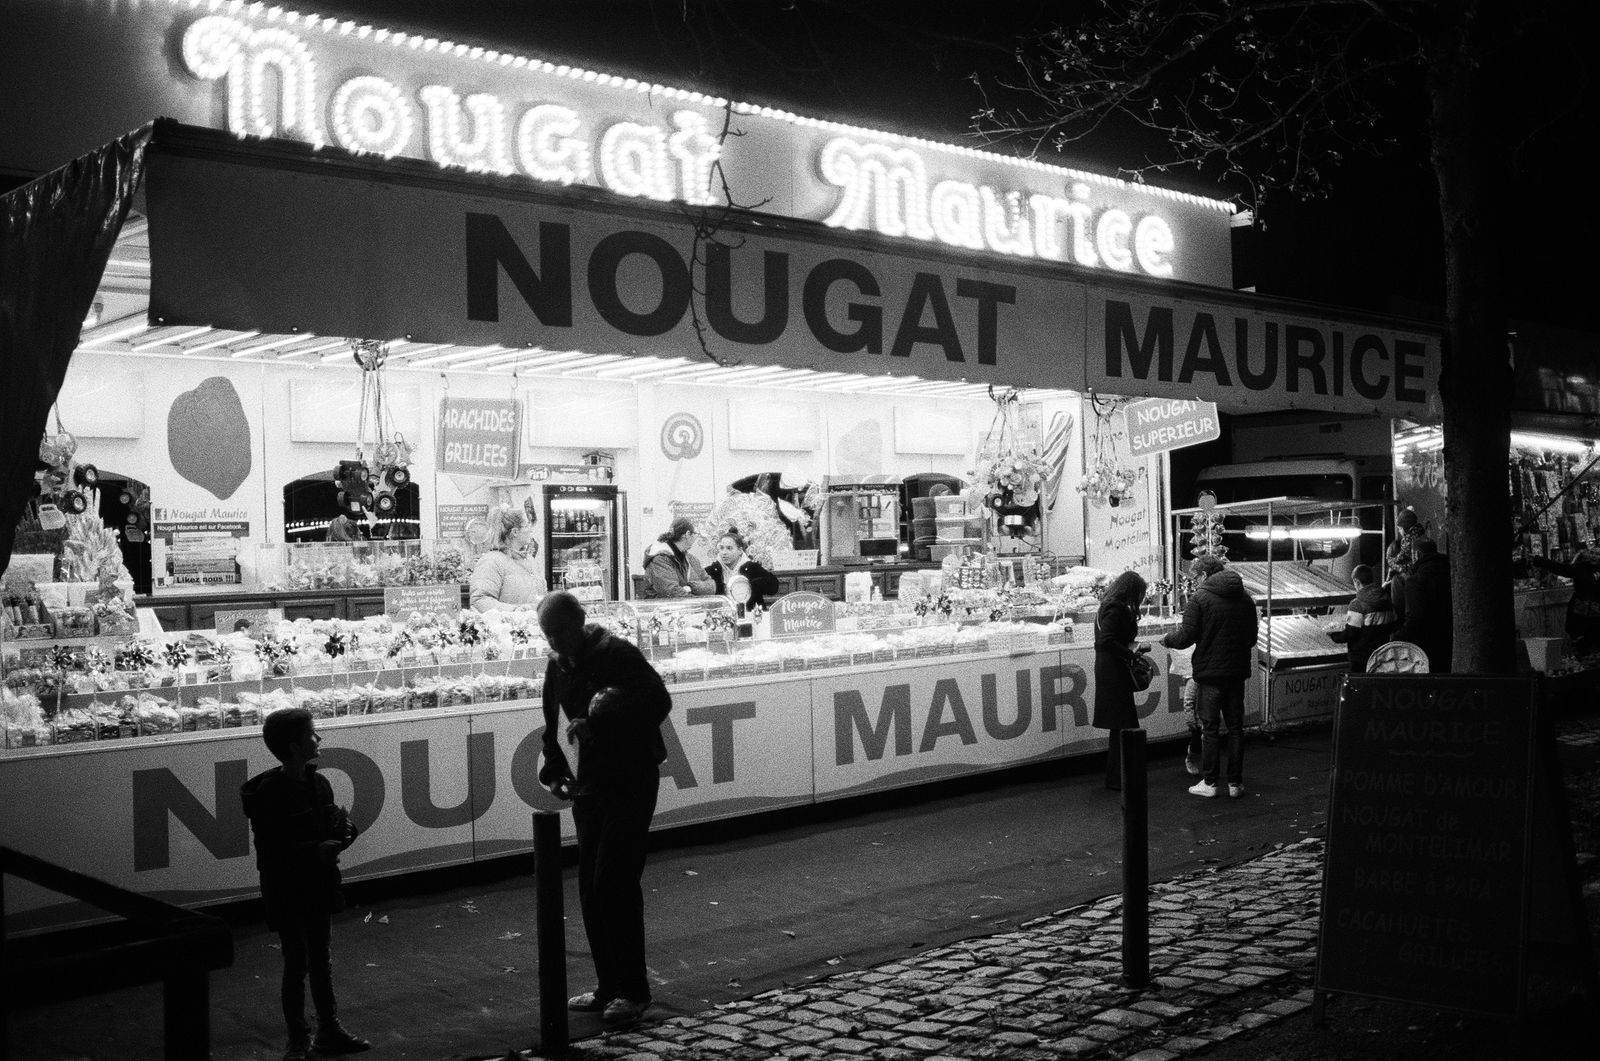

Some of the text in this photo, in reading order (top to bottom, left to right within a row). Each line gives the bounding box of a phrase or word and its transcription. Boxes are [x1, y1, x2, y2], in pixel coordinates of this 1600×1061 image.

[465, 211, 1427, 402] NOUGAT MAURICE
[443, 408, 516, 433] ARACHIDES
[1136, 400, 1198, 426] NOUGAT
[1132, 417, 1215, 451] SUPERIEUR
[445, 442, 508, 467] GRILLEES
[171, 508, 207, 522] Nougat
[210, 507, 248, 519] Maurice
[1110, 508, 1147, 530] Nougat
[177, 576, 200, 584] Likez
[202, 575, 223, 583] nous
[781, 598, 826, 615] Nougat
[783, 615, 823, 632] Maurice
[1285, 675, 1328, 696] NOUGAT
[833, 652, 1185, 767] MAURC
[1370, 687, 1496, 713] NOUGAT
[1363, 719, 1502, 746] MAURICE
[1343, 768, 1519, 801] POMME D'AMOUR
[1342, 805, 1460, 833] NOUGAT de
[1364, 832, 1513, 864] MONTELIMAR
[1353, 867, 1417, 895] BARBE
[1444, 875, 1493, 901] PAPA
[1336, 907, 1474, 944] CACAHUETES
[1398, 942, 1503, 973] GRILLEES
